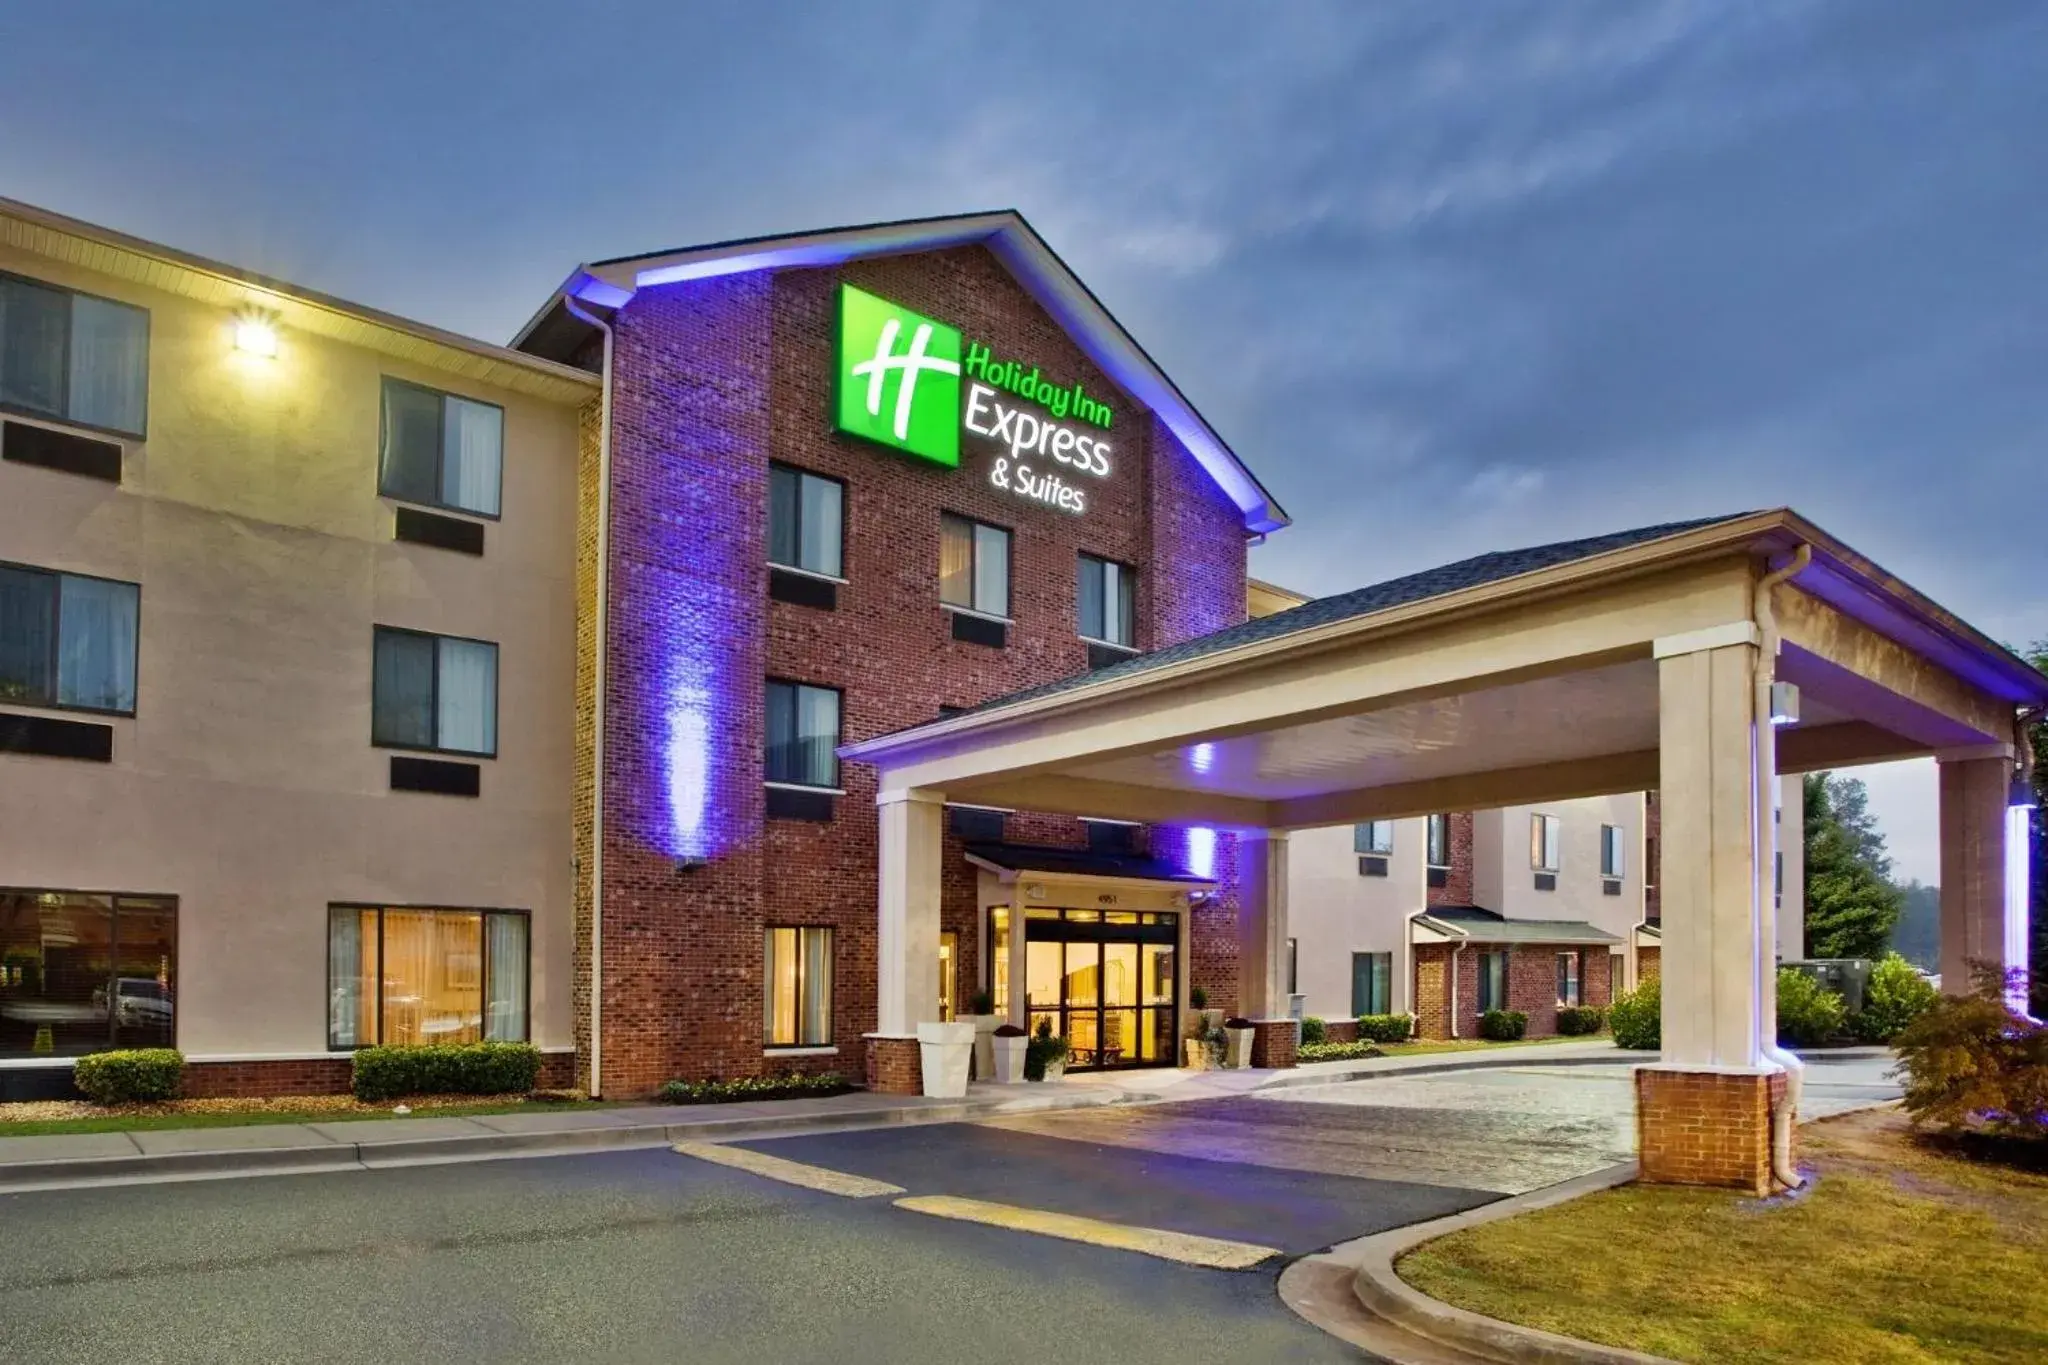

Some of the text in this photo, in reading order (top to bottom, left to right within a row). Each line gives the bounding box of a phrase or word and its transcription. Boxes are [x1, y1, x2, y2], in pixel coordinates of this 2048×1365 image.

[965, 342, 1112, 429] Holiday Inn
[964, 382, 1111, 477] Express
[990, 457, 1085, 512] & Suites
